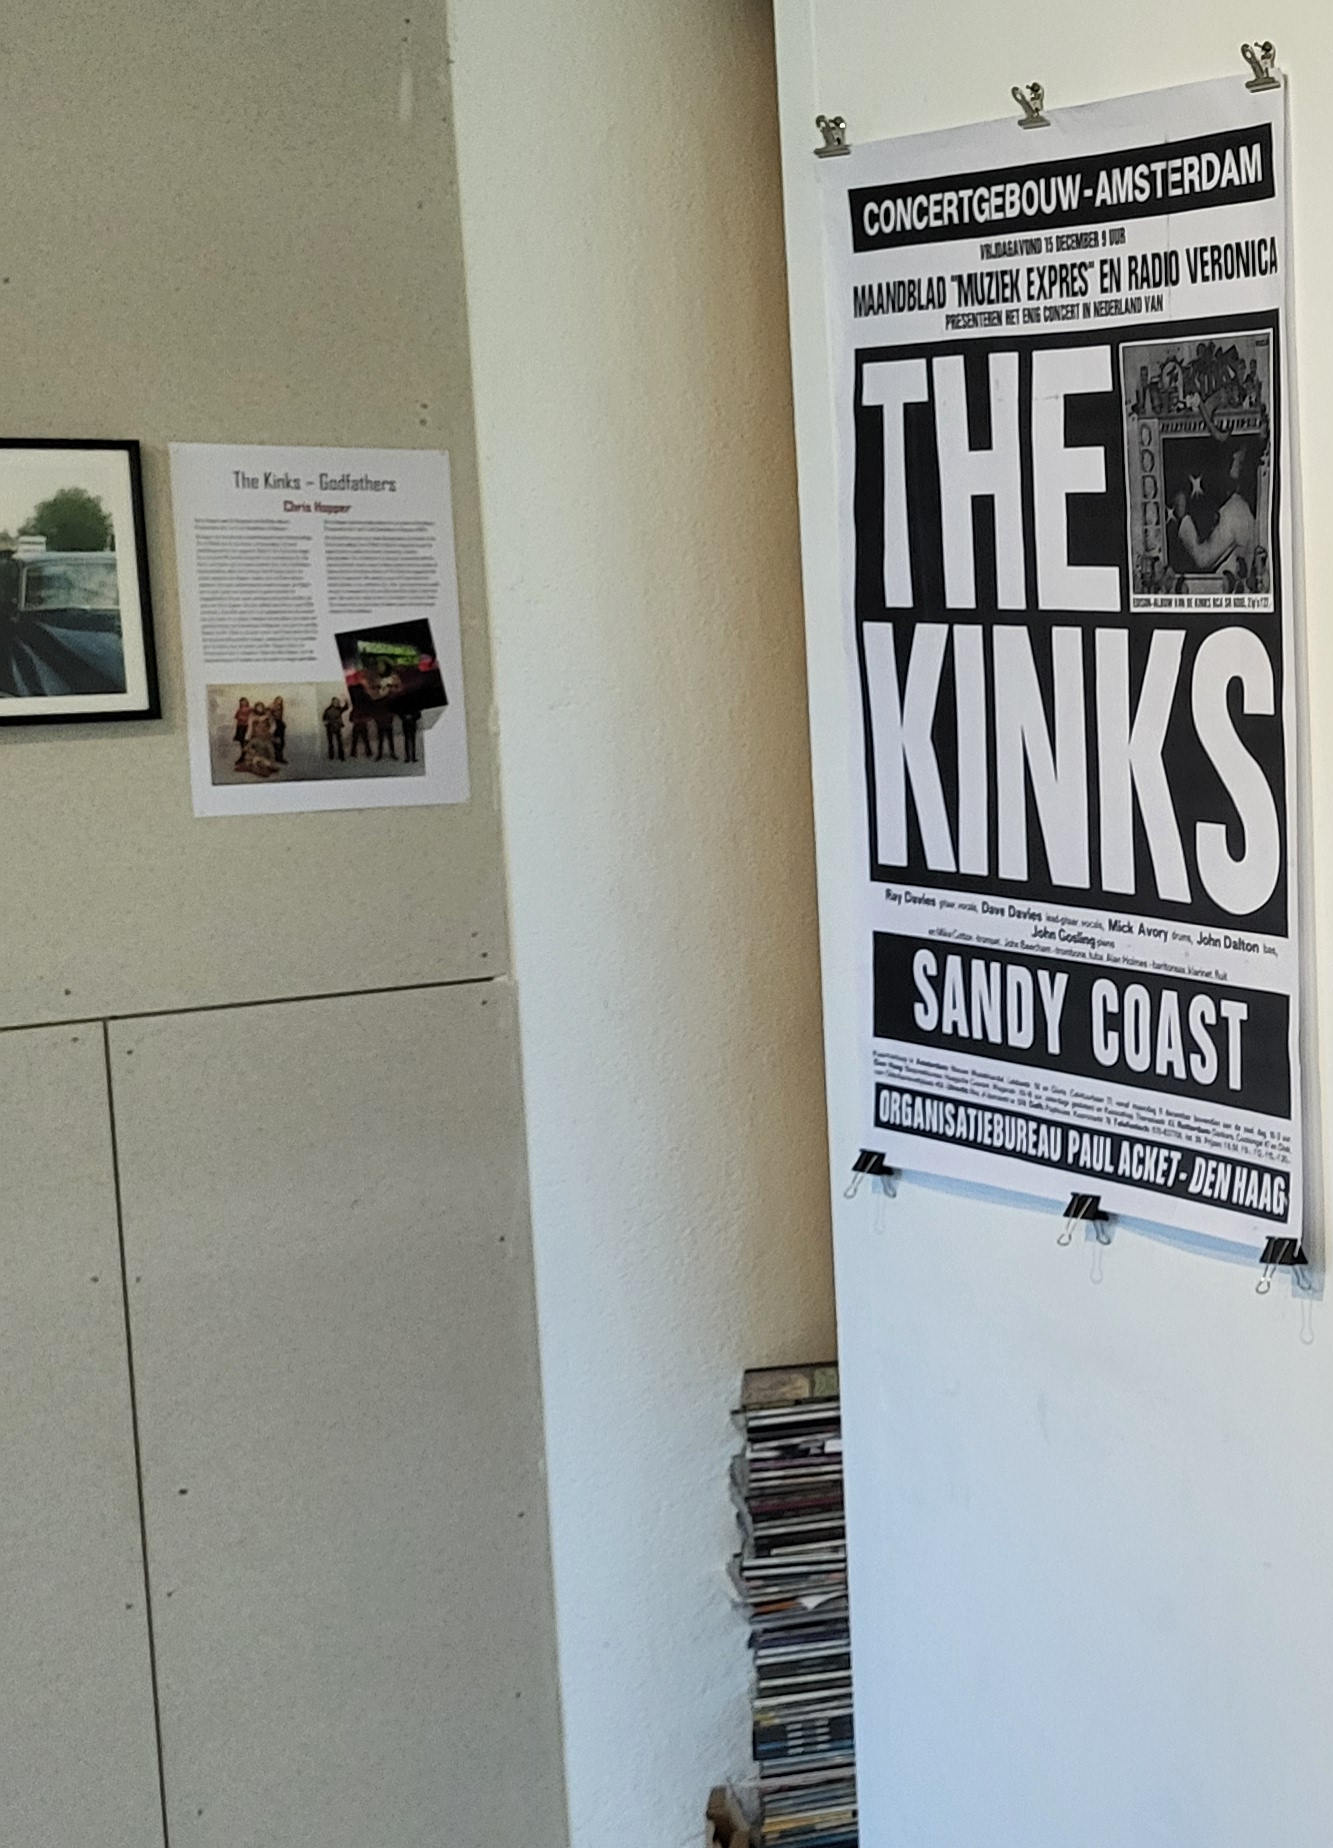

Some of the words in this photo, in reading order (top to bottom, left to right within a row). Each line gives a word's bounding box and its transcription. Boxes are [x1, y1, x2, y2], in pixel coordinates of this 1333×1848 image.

[863, 143, 1263, 236] CONCERTGEBOUW-AMSTERDAM
[1055, 231, 1099, 253] DECEMBER
[1101, 230, 1107, 247] 9
[1109, 227, 1126, 246] UUR
[853, 276, 947, 318] MAANDBLAD
[950, 268, 1021, 308] "MUZIEK
[1026, 260, 1094, 301] EXPRES"
[1100, 257, 1121, 294] EN
[1128, 250, 1180, 291] RADIO
[1185, 236, 1278, 284] VERONICA
[945, 309, 1003, 330] PRESENTEREN
[1005, 308, 1020, 326] HET
[1043, 302, 1080, 323] CONCERT
[1082, 301, 1091, 319] IN
[1093, 297, 1142, 318] NEDERLAND
[1144, 294, 1164, 313] VAN
[233, 470, 259, 489] The
[264, 471, 301, 490] Kinks
[319, 472, 397, 492] Godfathers
[283, 500, 312, 513] Chris
[862, 345, 1121, 611] THE
[862, 621, 1280, 915] KINKS
[885, 888, 902, 906] Ray
[904, 890, 936, 907] Davies
[981, 900, 1005, 917] Dave
[1008, 905, 1042, 922] Davies
[1108, 918, 1134, 934] Mick
[1138, 922, 1168, 943] Avory
[1196, 931, 1221, 948] John
[1223, 935, 1260, 953] Dalton
[1031, 925, 1056, 940] John
[1058, 928, 1096, 949] Gosling
[912, 948, 1069, 1056] SANDY
[1091, 978, 1248, 1091] COAST
[879, 1089, 1062, 1160] ORGANISATIEBUREAU
[1067, 1129, 1114, 1173] PAUL
[1188, 1156, 1232, 1201] DEN
[1233, 1166, 1287, 1216] HAAG
